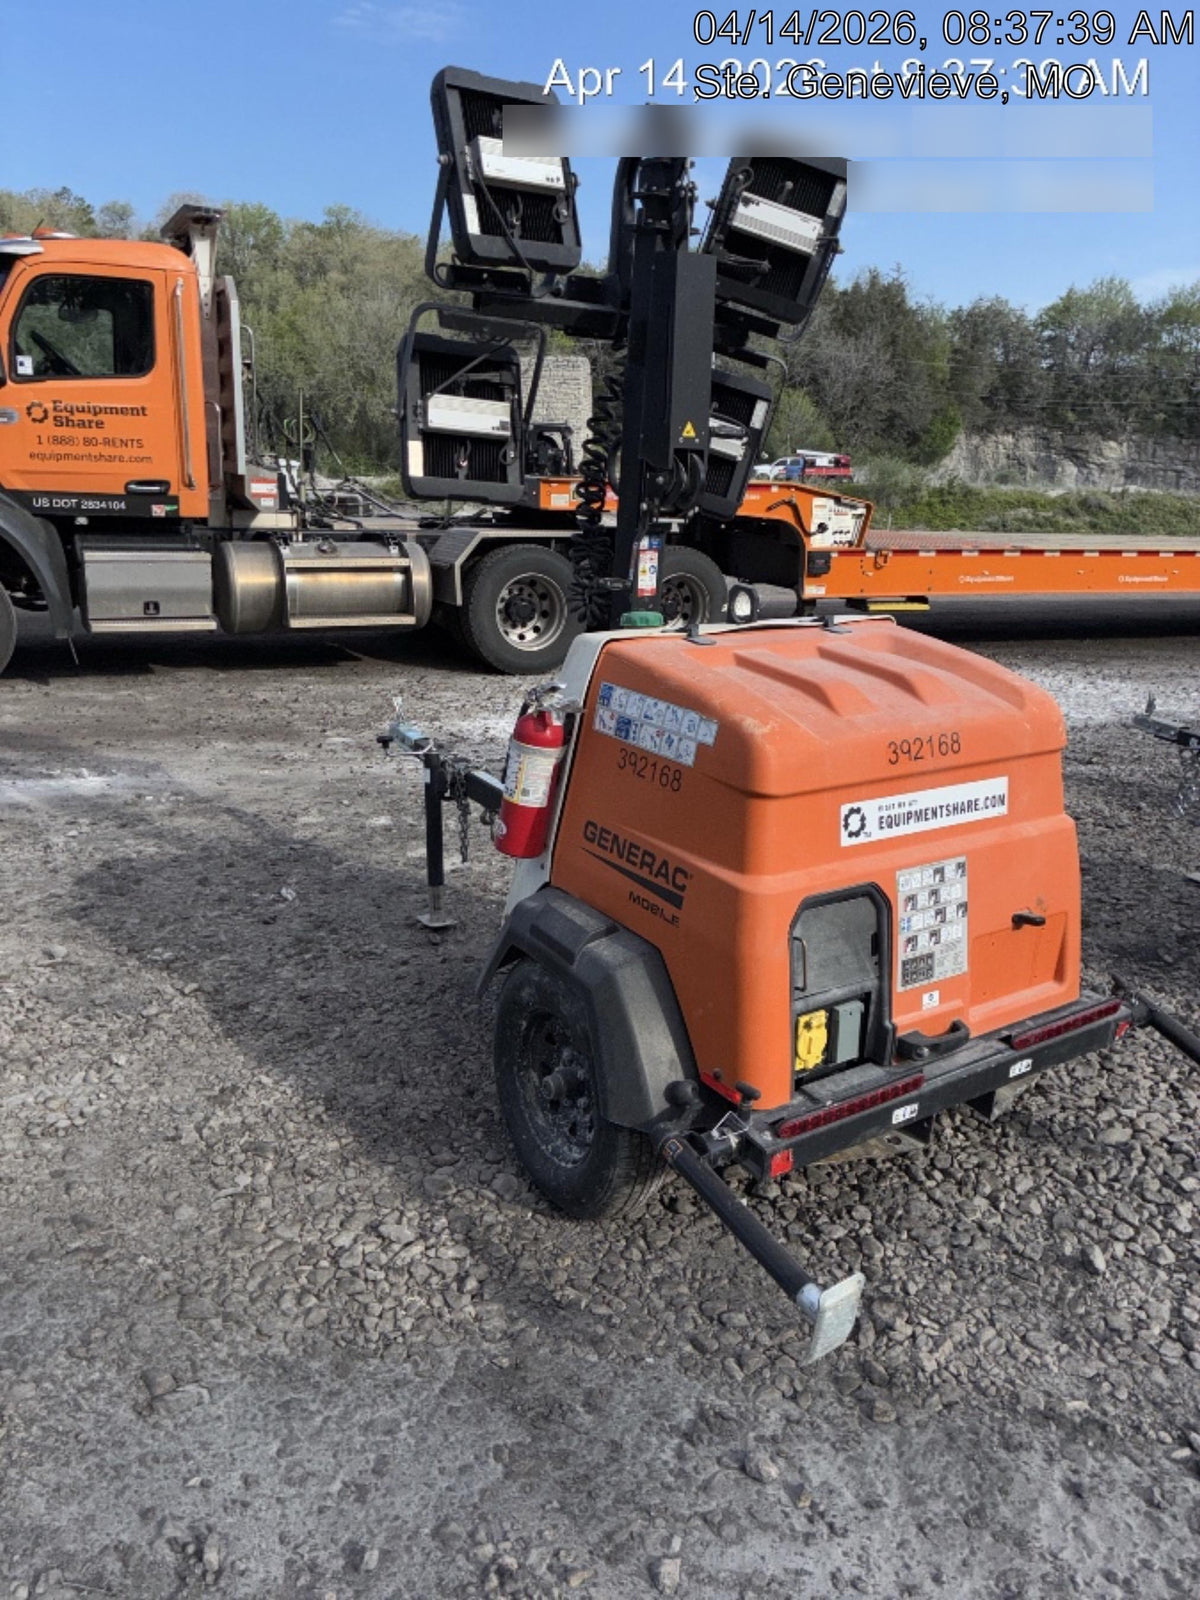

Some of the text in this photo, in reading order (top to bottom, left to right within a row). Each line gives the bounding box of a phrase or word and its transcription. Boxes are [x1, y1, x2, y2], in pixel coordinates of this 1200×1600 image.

[52, 400, 148, 416] Equipment
[53, 415, 105, 429] Share
[36, 435, 145, 449] 1 (888) 80-RENTS
[29, 451, 154, 464] equipmentshare.com
[33, 498, 50, 508] US
[52, 499, 79, 508] DOT
[888, 732, 961, 766] 392168
[617, 748, 682, 793] 392168
[878, 793, 1006, 831] EQUIPMENTSHARE.COM
[583, 820, 689, 893] GENERAC
[629, 891, 680, 927] MOBILE
